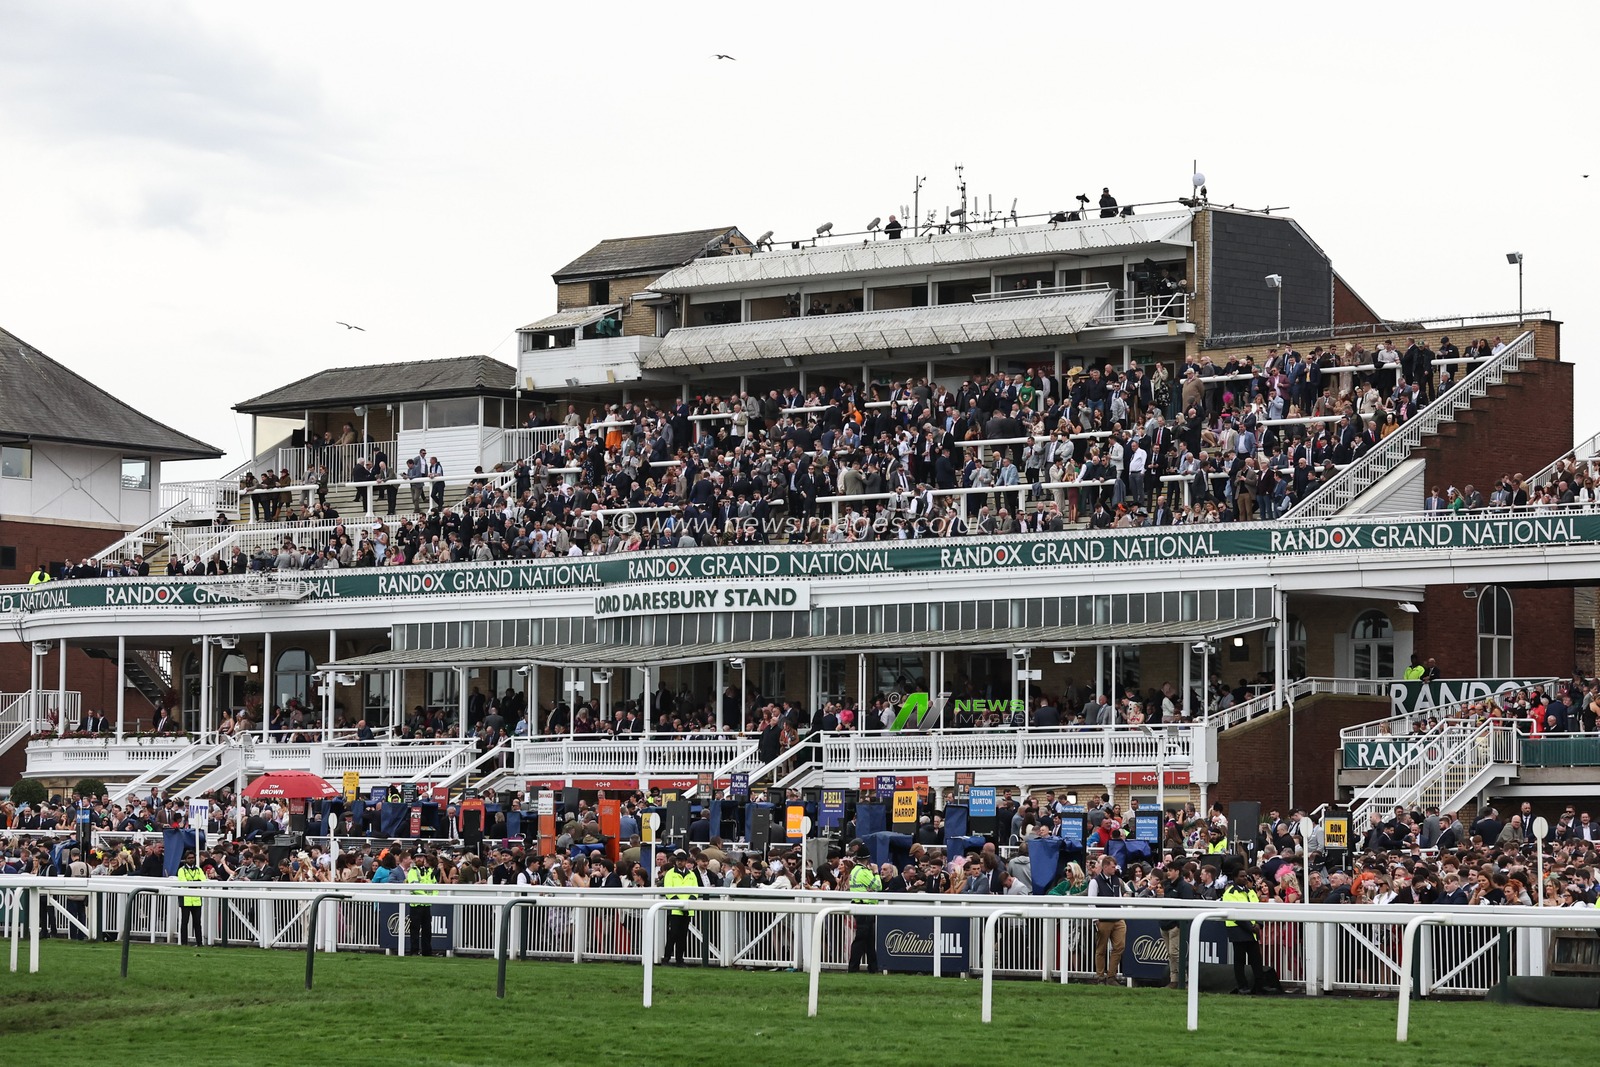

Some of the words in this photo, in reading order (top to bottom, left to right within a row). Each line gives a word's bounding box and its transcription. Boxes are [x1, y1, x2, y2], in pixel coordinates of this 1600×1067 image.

[1271, 526, 1362, 552] RANDOX
[1371, 523, 1452, 547] GRAND
[1462, 517, 1581, 545] NATIONAL
[941, 544, 1022, 569] RANDOX
[1031, 540, 1105, 565] GRAND
[1113, 533, 1220, 560] NATIONAL
[628, 556, 692, 580] RANDOX
[700, 552, 780, 577] GRAND
[789, 550, 894, 574] NATIONAL
[378, 571, 446, 594] RANDOX
[453, 567, 513, 590] GRAND
[519, 563, 601, 587] NATIONAL
[20, 589, 71, 611] NATIONAL
[105, 586, 184, 605] RANDOX
[595, 594, 621, 614] LORD
[623, 589, 719, 612] DARESBURY
[724, 587, 797, 607] STAND
[897, 796, 913, 806] MARK
[970, 789, 994, 797] STEWART
[894, 807, 915, 818] HARROP
[1326, 834, 1346, 843] WADEY
[885, 929, 936, 954] William
